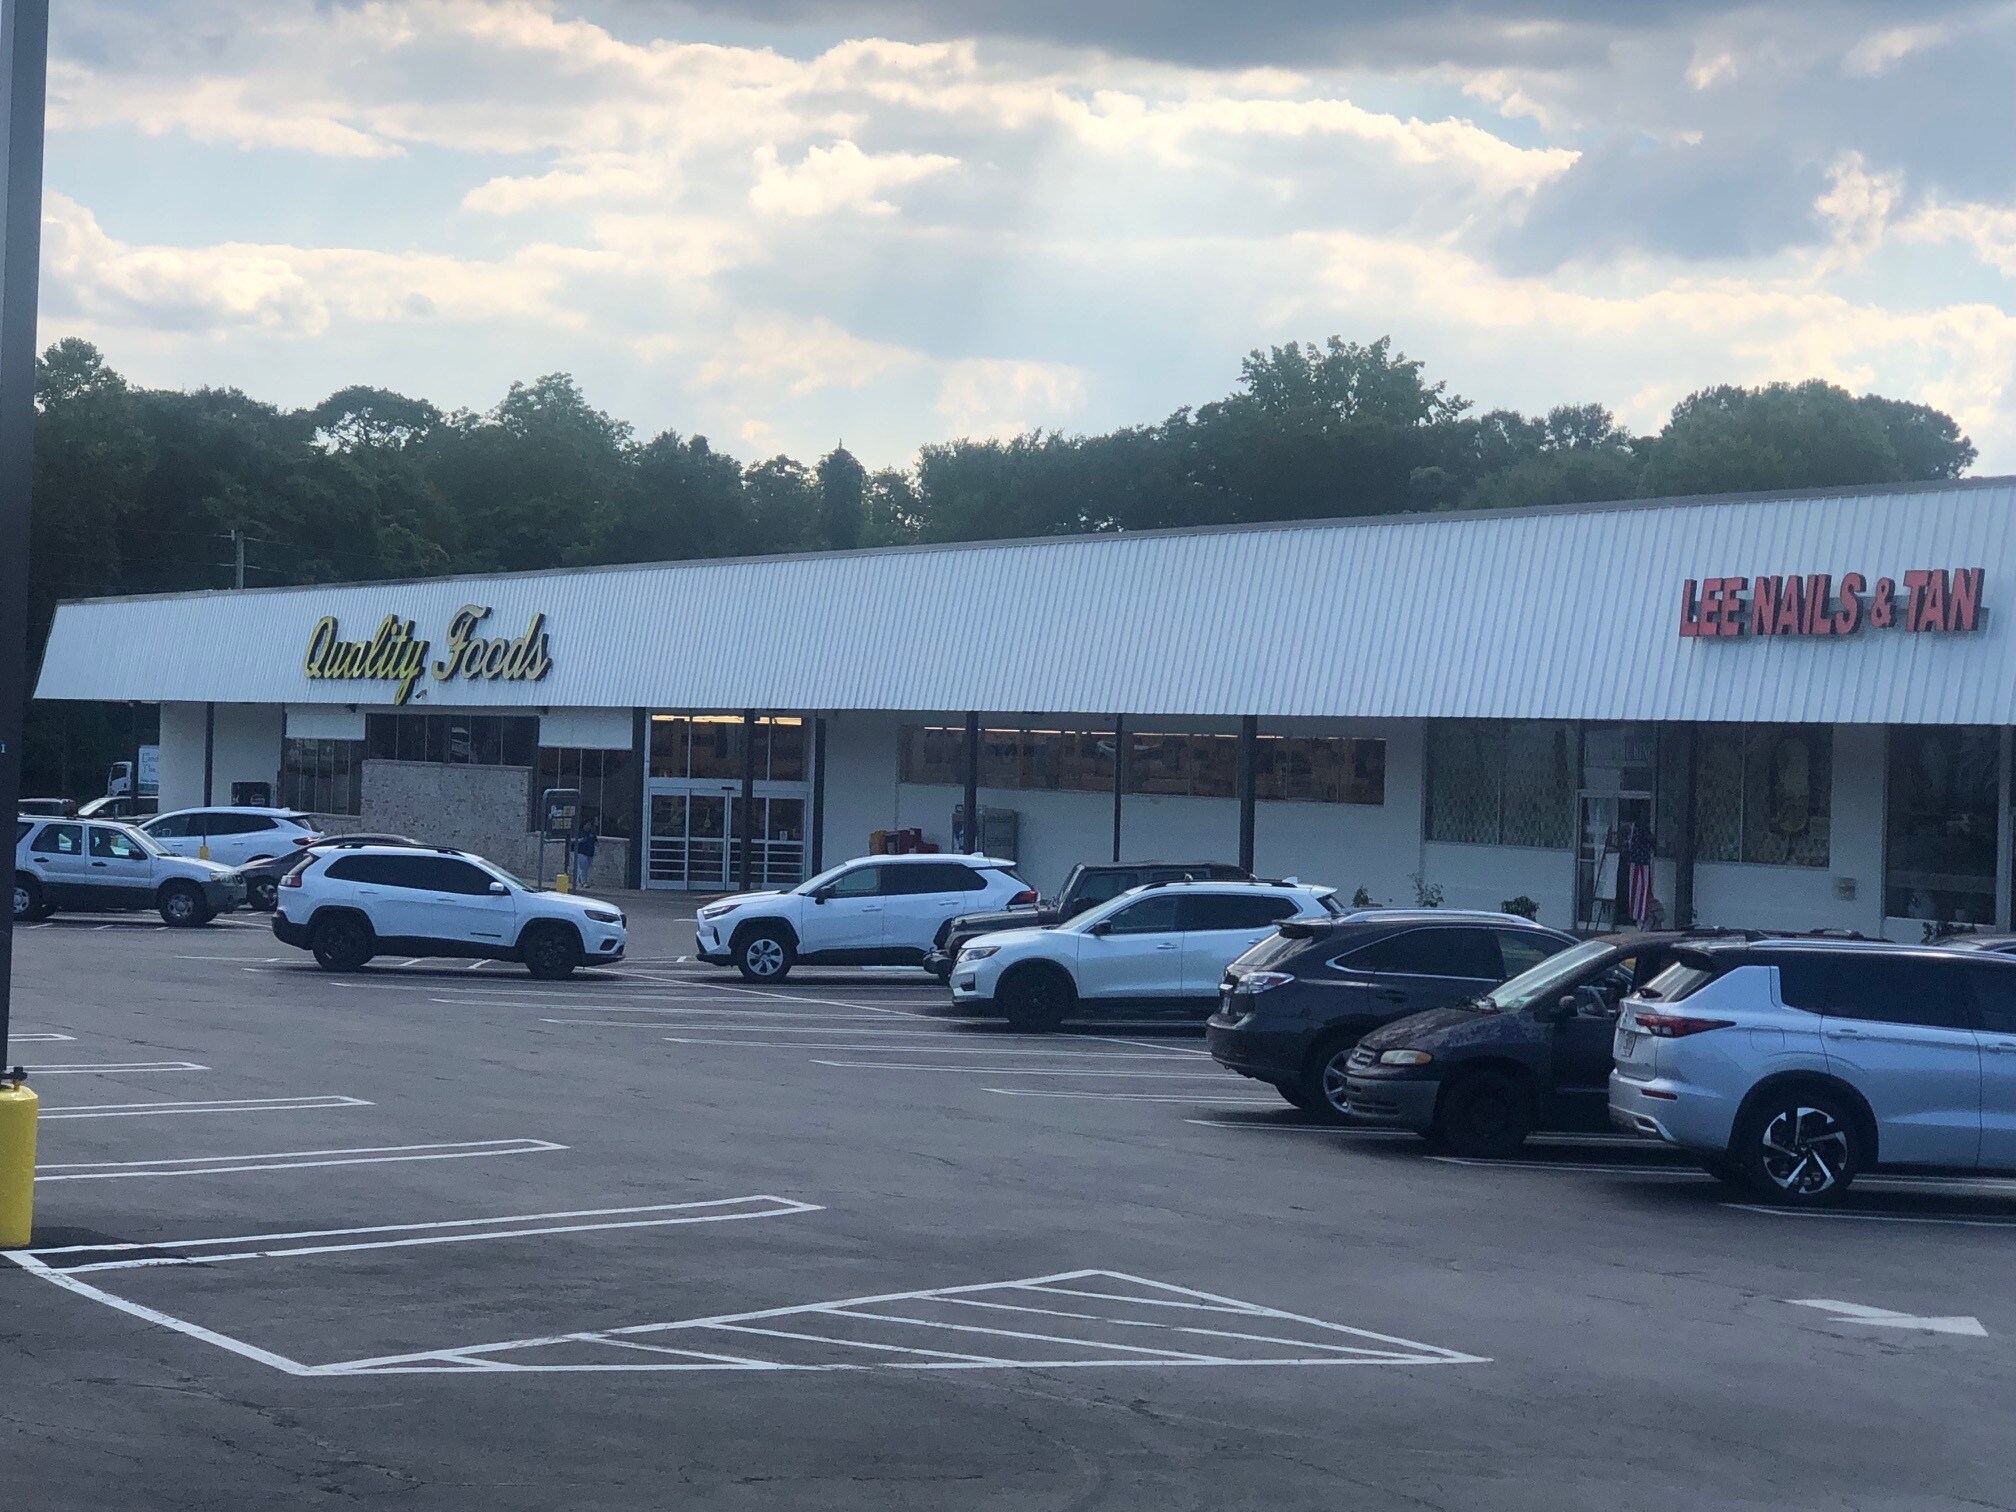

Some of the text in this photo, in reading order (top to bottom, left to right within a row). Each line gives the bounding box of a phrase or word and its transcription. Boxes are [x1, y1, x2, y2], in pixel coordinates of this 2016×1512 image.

[1680, 567, 1985, 637] LEE NAILS & TAN
[304, 604, 552, 706] Quality Foods
